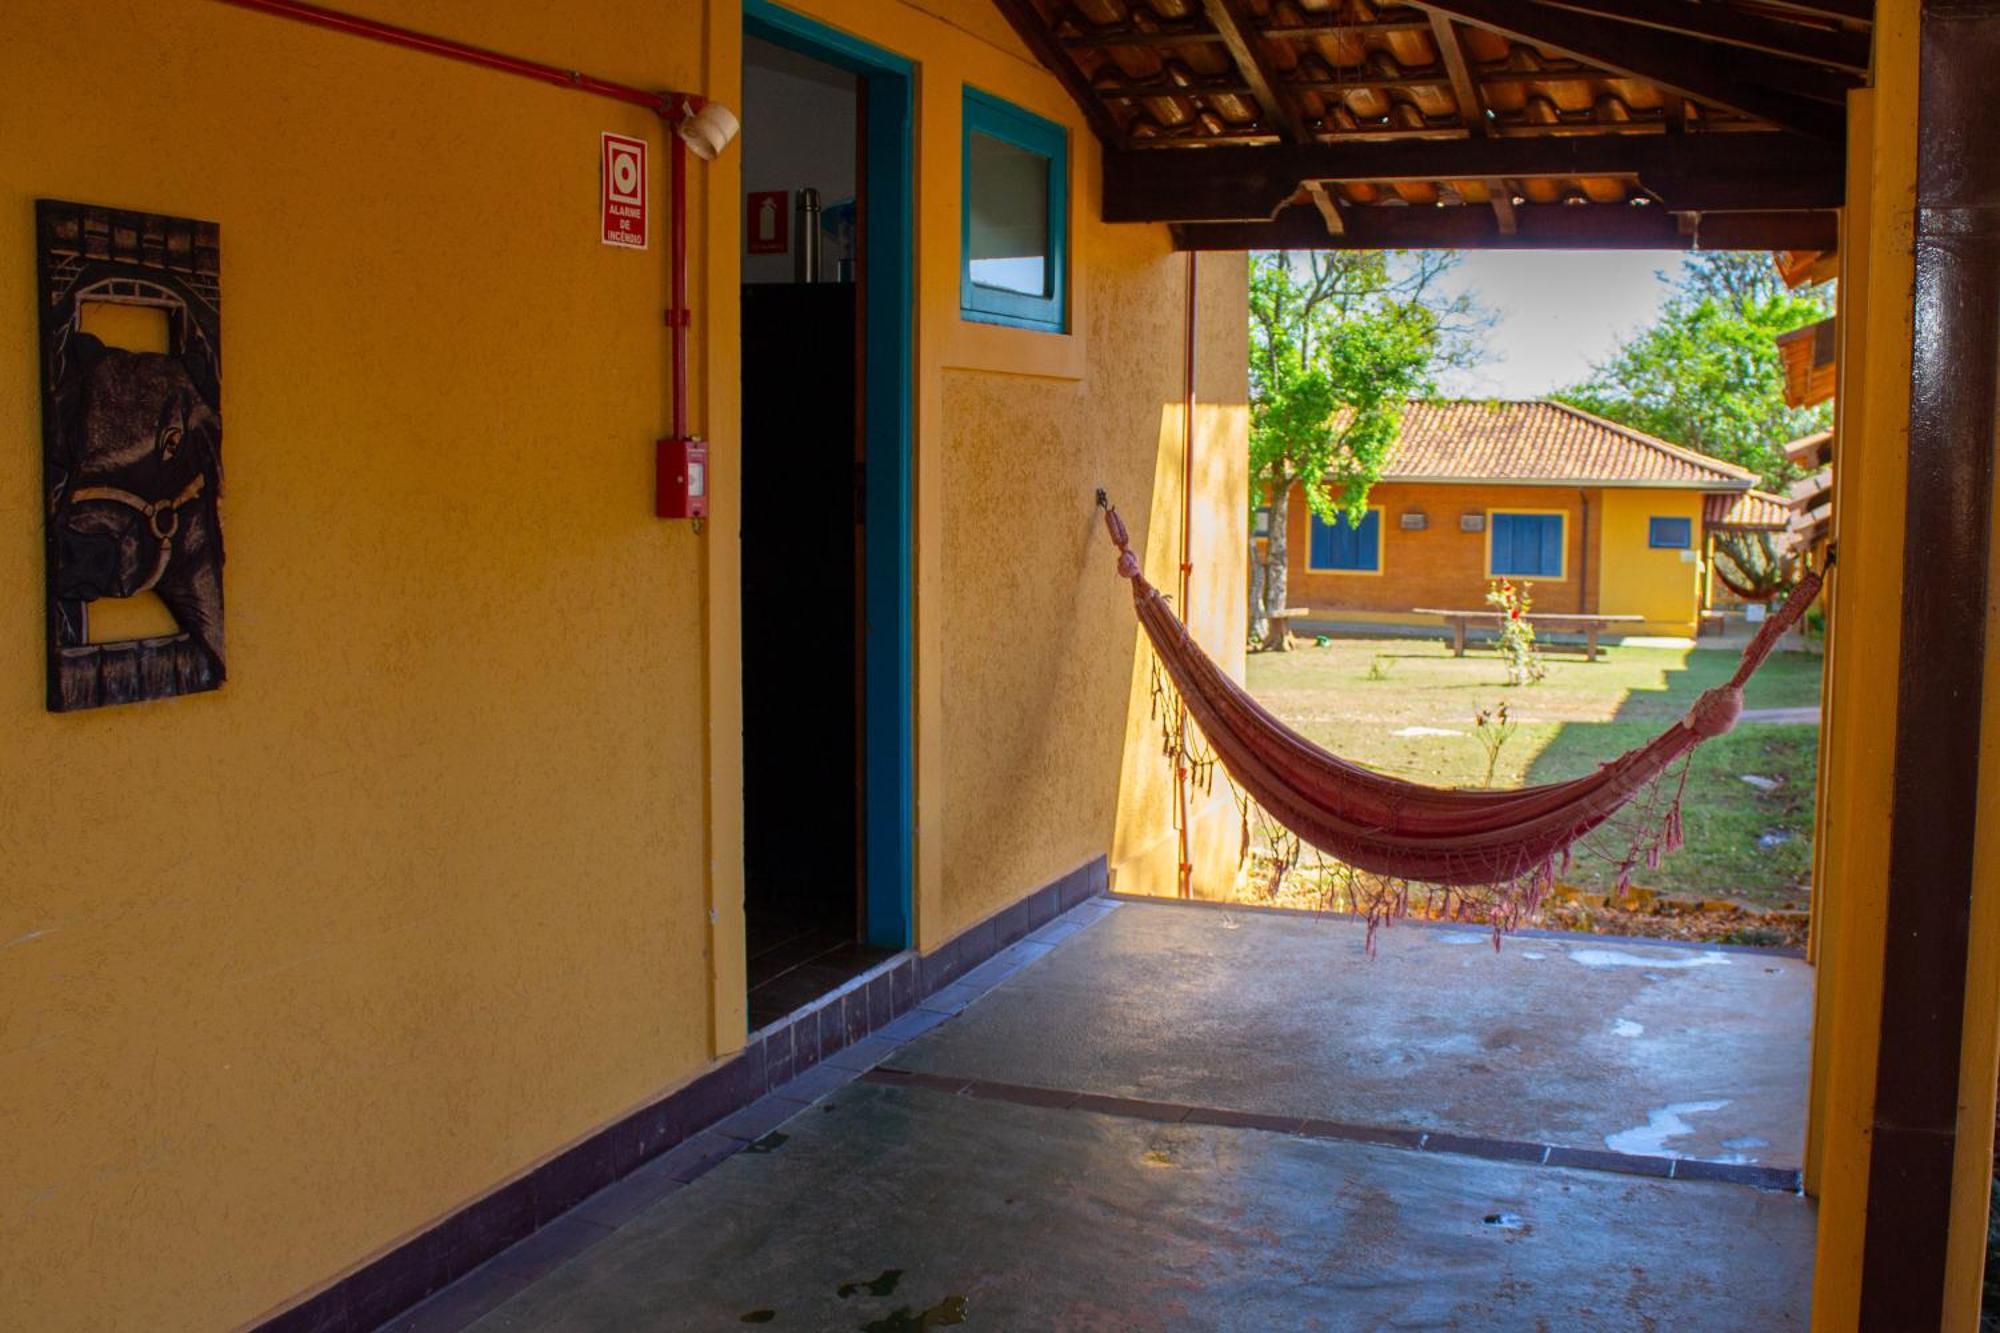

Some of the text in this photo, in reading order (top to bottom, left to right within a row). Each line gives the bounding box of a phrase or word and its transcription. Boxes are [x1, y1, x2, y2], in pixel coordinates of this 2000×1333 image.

[609, 205, 641, 218] ALARME
[619, 219, 631, 230] DE
[607, 230, 641, 244] INCÊNDIO
